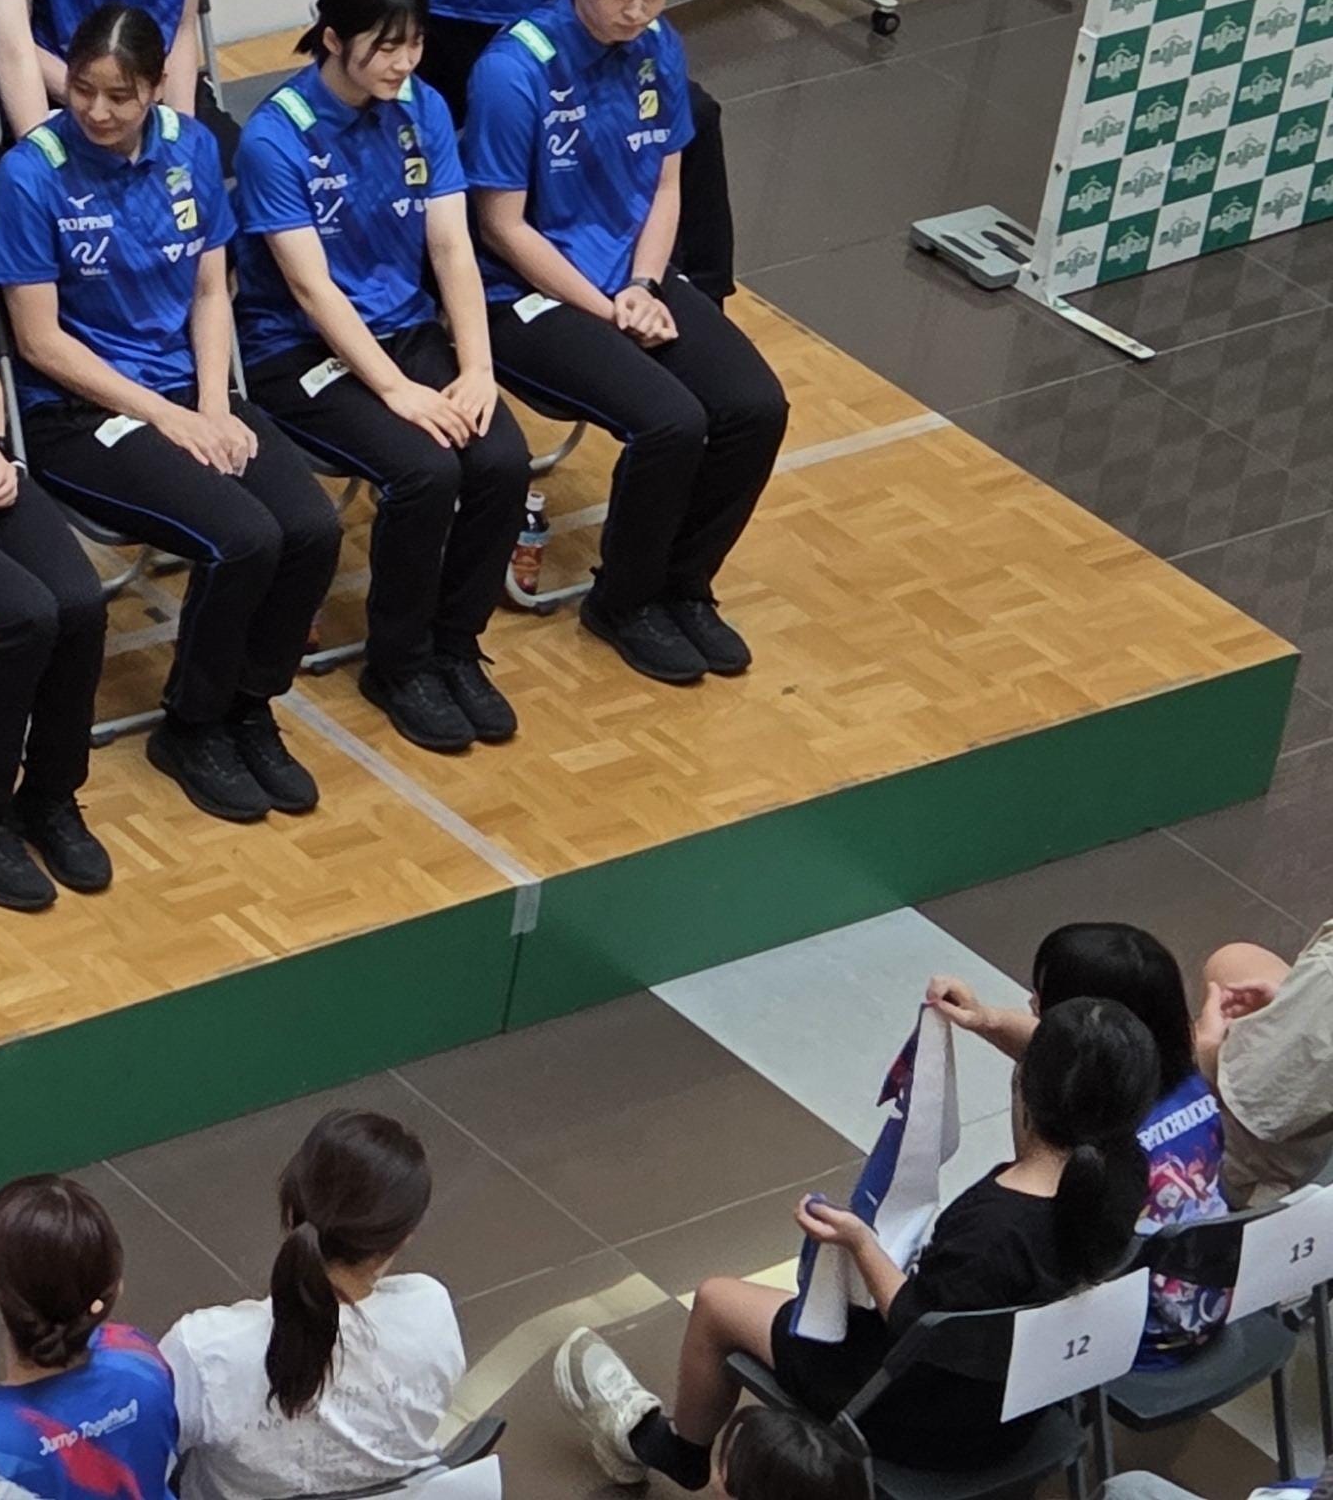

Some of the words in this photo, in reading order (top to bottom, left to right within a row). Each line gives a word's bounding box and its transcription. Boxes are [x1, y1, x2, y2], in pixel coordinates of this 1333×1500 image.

[57, 213, 114, 233] TOPPAN
[1288, 1237, 1316, 1264] 13
[1063, 1333, 1091, 1361] 12
[38, 1429, 78, 1458] Jump
